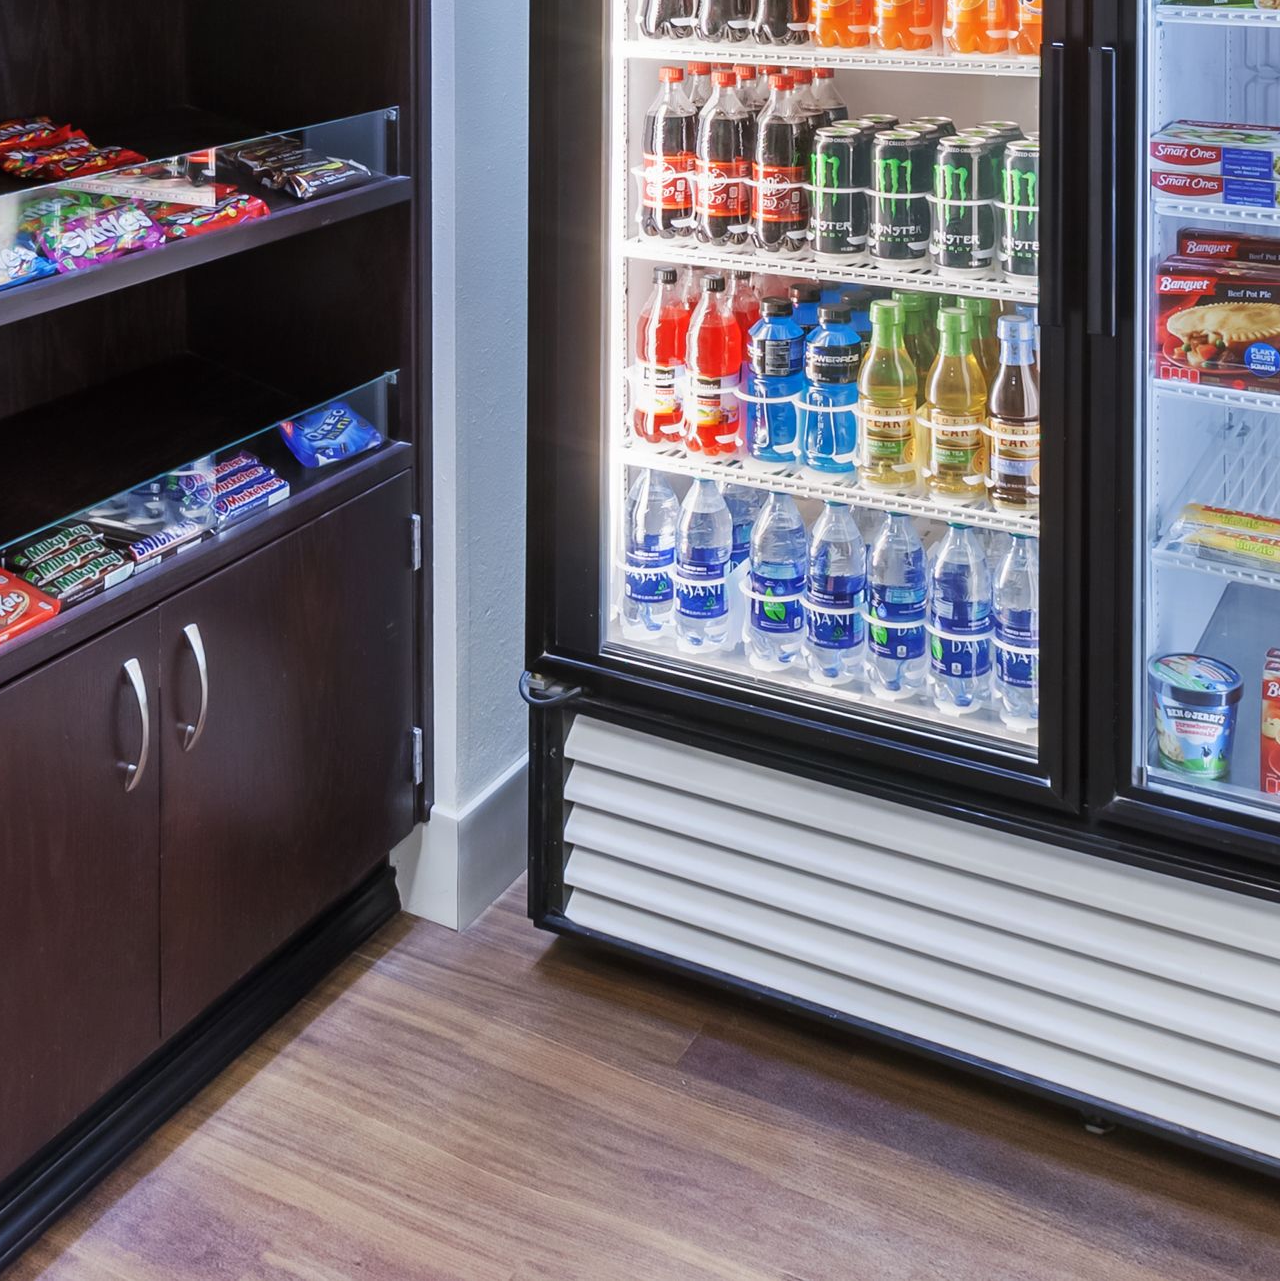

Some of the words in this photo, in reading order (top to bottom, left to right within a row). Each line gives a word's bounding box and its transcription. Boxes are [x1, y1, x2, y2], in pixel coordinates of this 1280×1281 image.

[1155, 144, 1189, 158] Smart
[1189, 147, 1217, 159] Ones
[1157, 174, 1190, 188] Smart
[1191, 177, 1218, 190] Ones
[61, 209, 153, 257] Skittles
[1186, 240, 1233, 256] Banquet
[1160, 276, 1210, 292] Banquet
[1227, 289, 1244, 299] Beef
[1245, 290, 1258, 299] Pot
[1250, 348, 1276, 357] FLAKY
[1251, 354, 1276, 362] CRUST
[304, 406, 347, 442] OREO
[226, 476, 286, 510] Musketeers
[1192, 709, 1226, 724] JERRY'S
